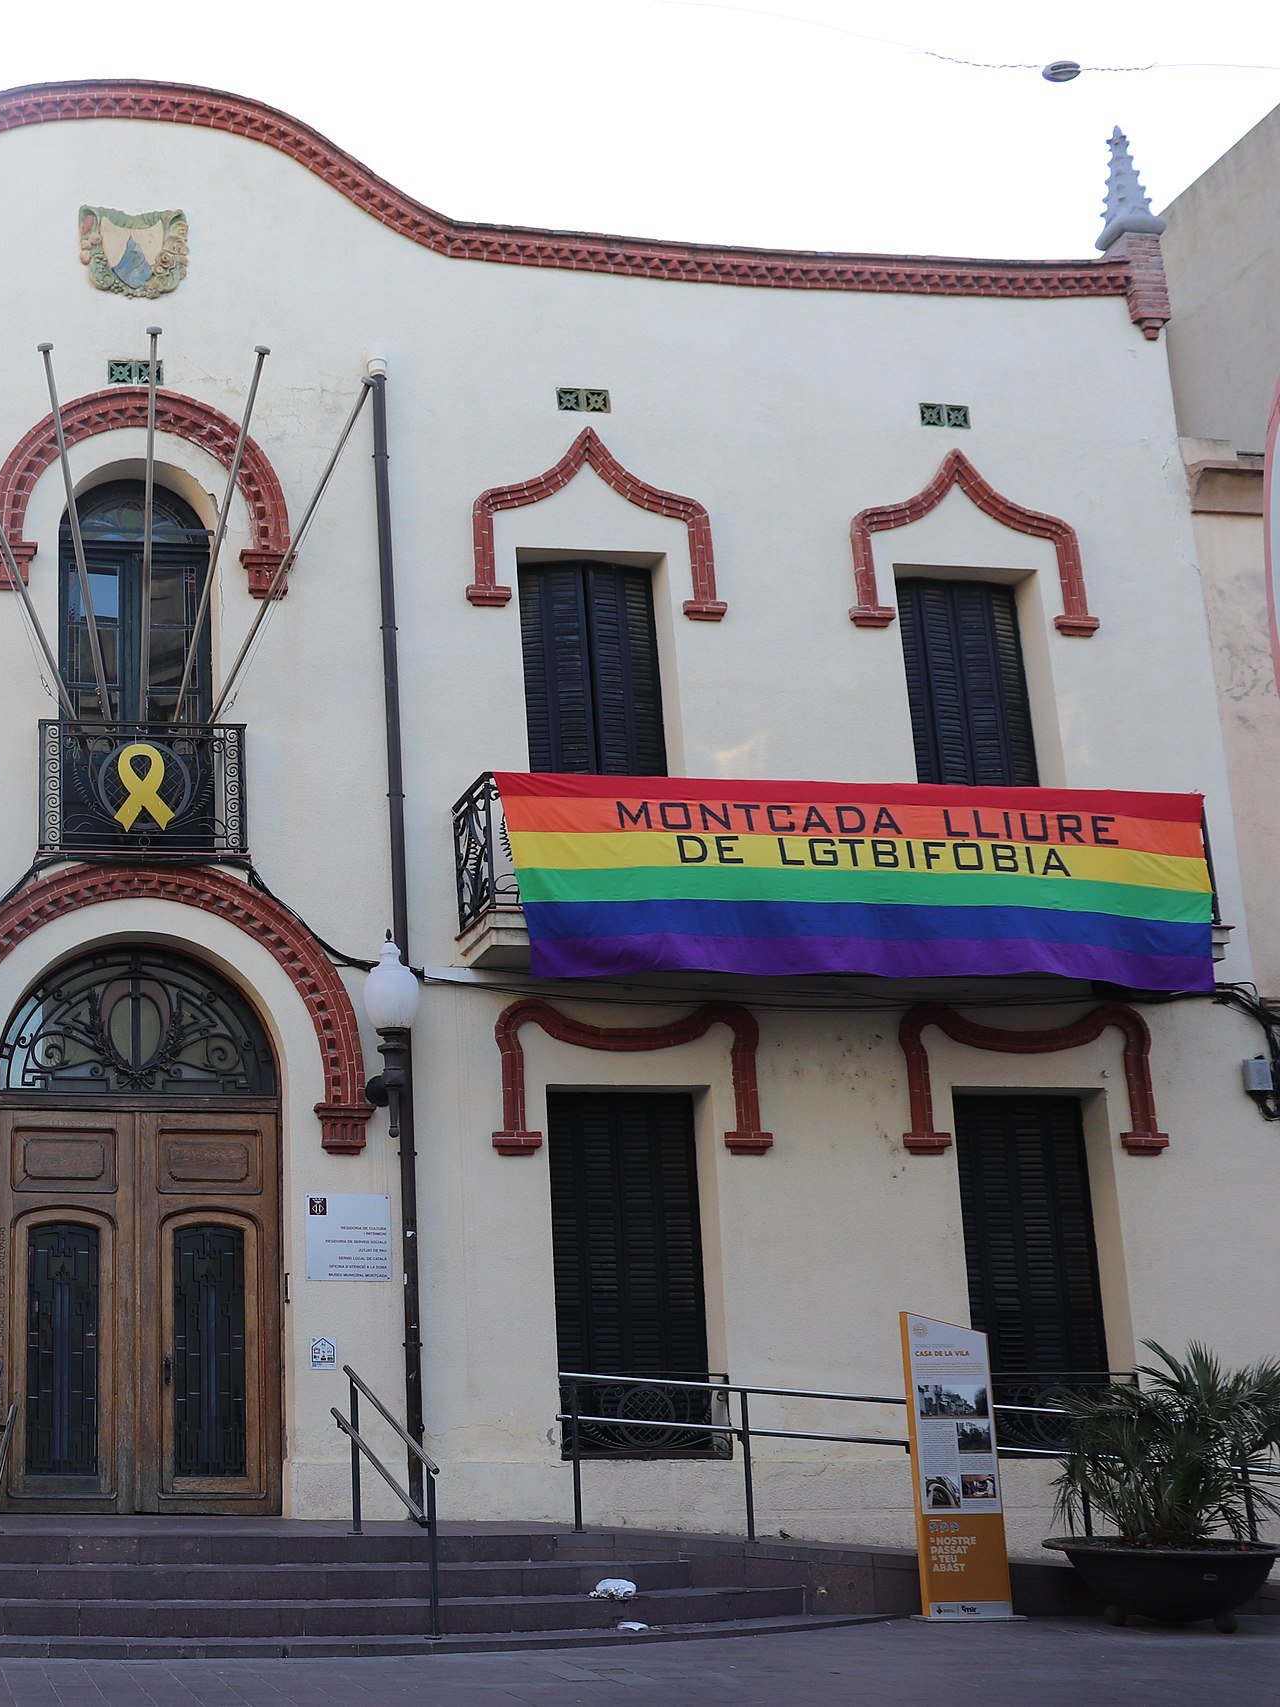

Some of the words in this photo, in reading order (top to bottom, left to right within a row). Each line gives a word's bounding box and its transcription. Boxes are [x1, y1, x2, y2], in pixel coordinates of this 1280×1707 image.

[615, 800, 903, 835] MONTCADA
[942, 809, 1119, 845] LLIURE
[676, 835, 744, 864] DE
[935, 1536, 977, 1546] NOSTRE
[930, 1545, 969, 1554] PASSAT
[938, 1554, 958, 1563] TEU
[932, 1563, 966, 1572] ABAST
